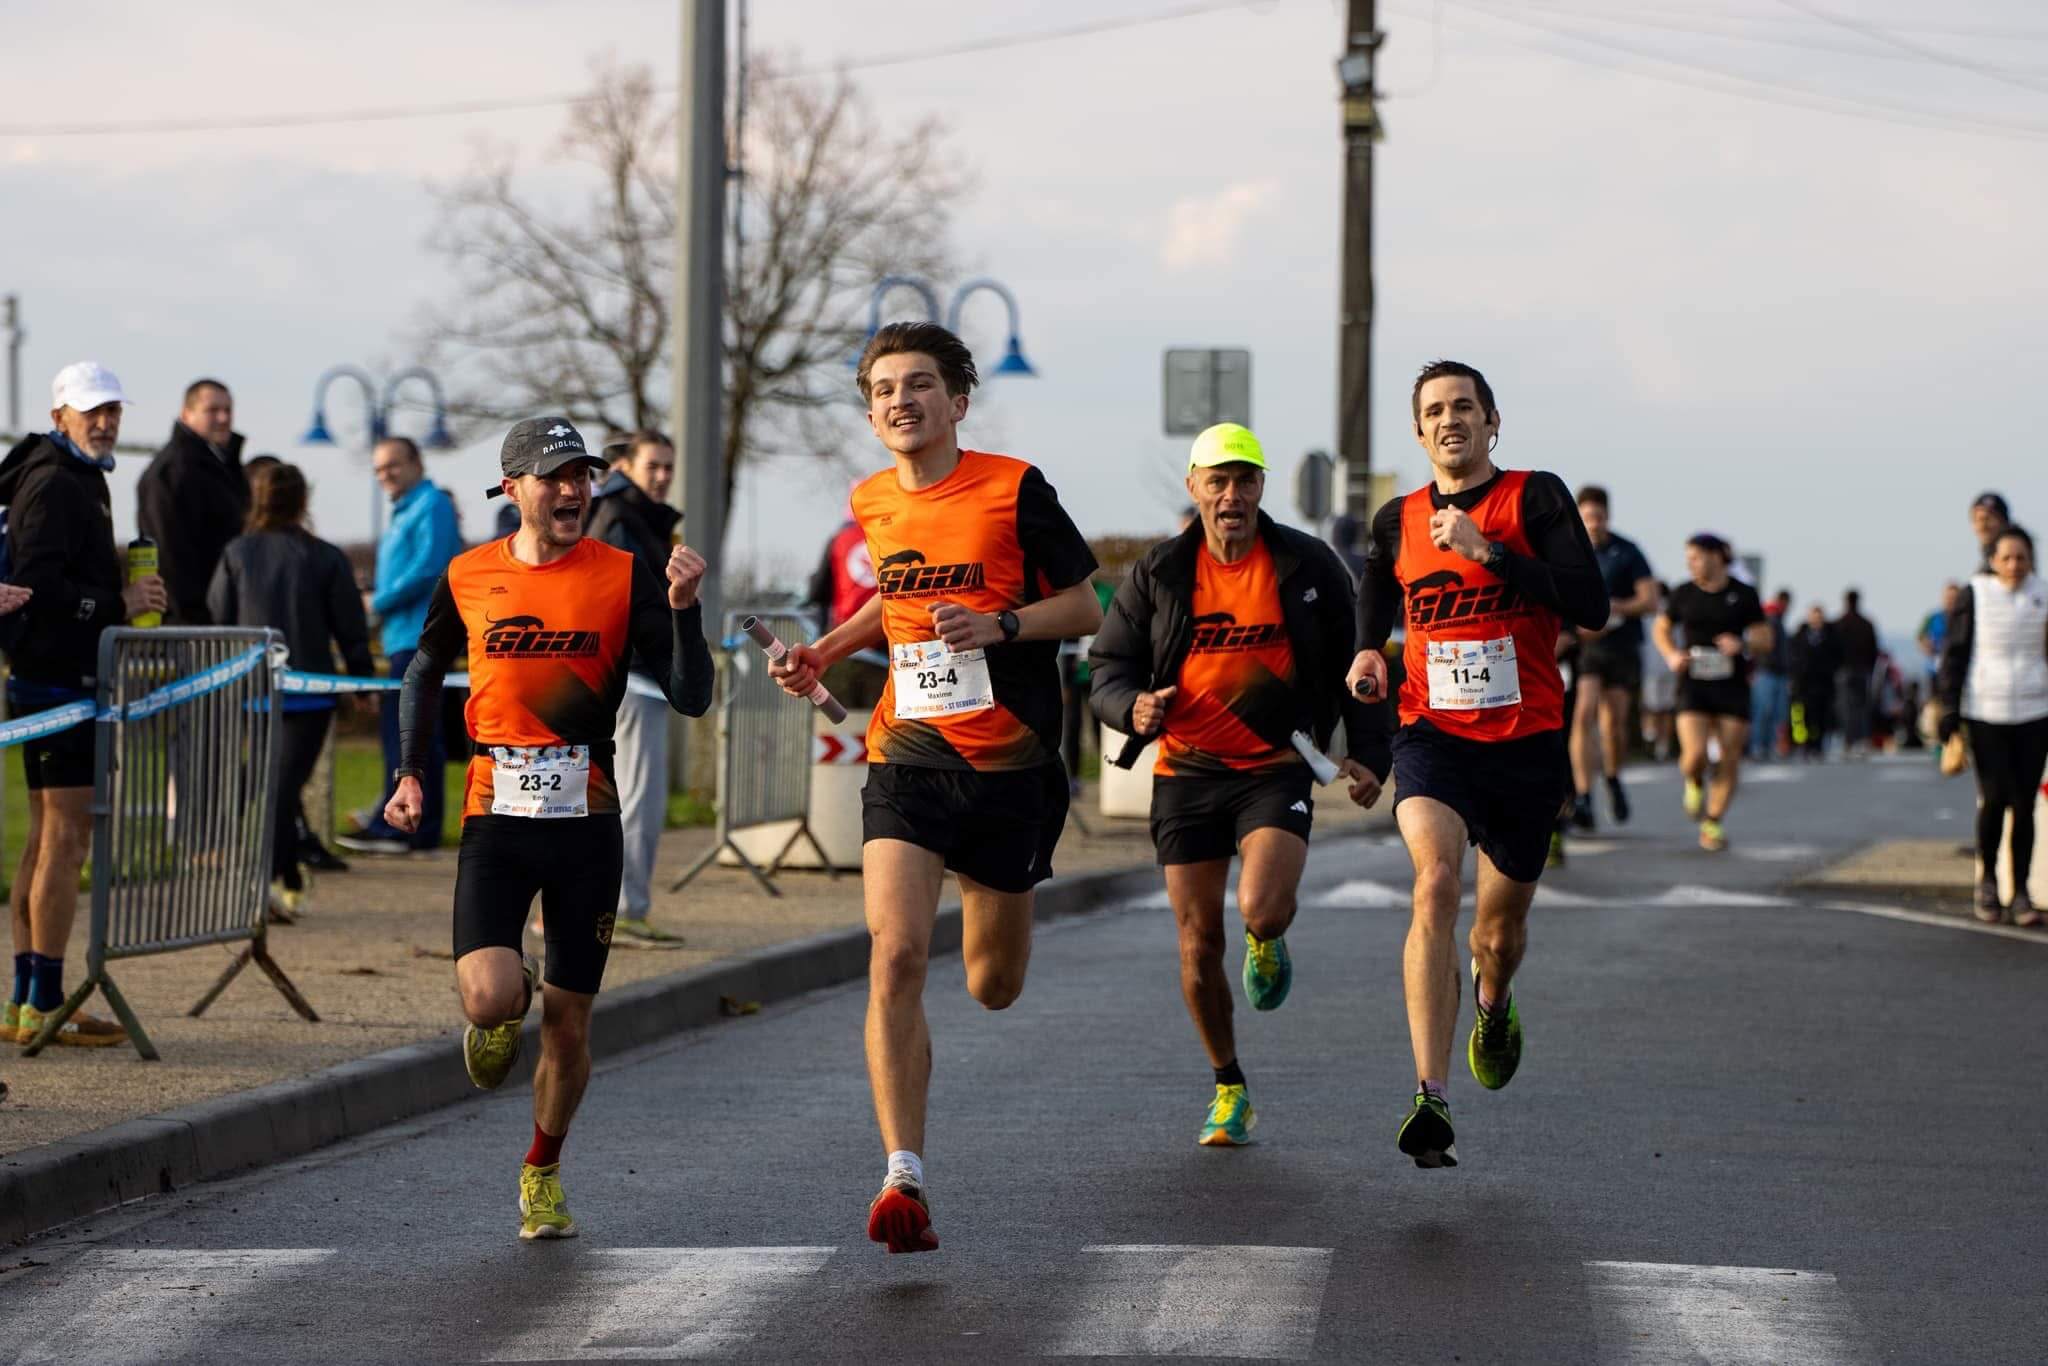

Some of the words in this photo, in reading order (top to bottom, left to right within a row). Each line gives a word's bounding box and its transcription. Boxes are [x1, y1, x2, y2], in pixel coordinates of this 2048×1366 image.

[918, 668, 958, 690] 23-4
[1451, 668, 1490, 684] 11-4
[520, 774, 561, 791] 23-2
